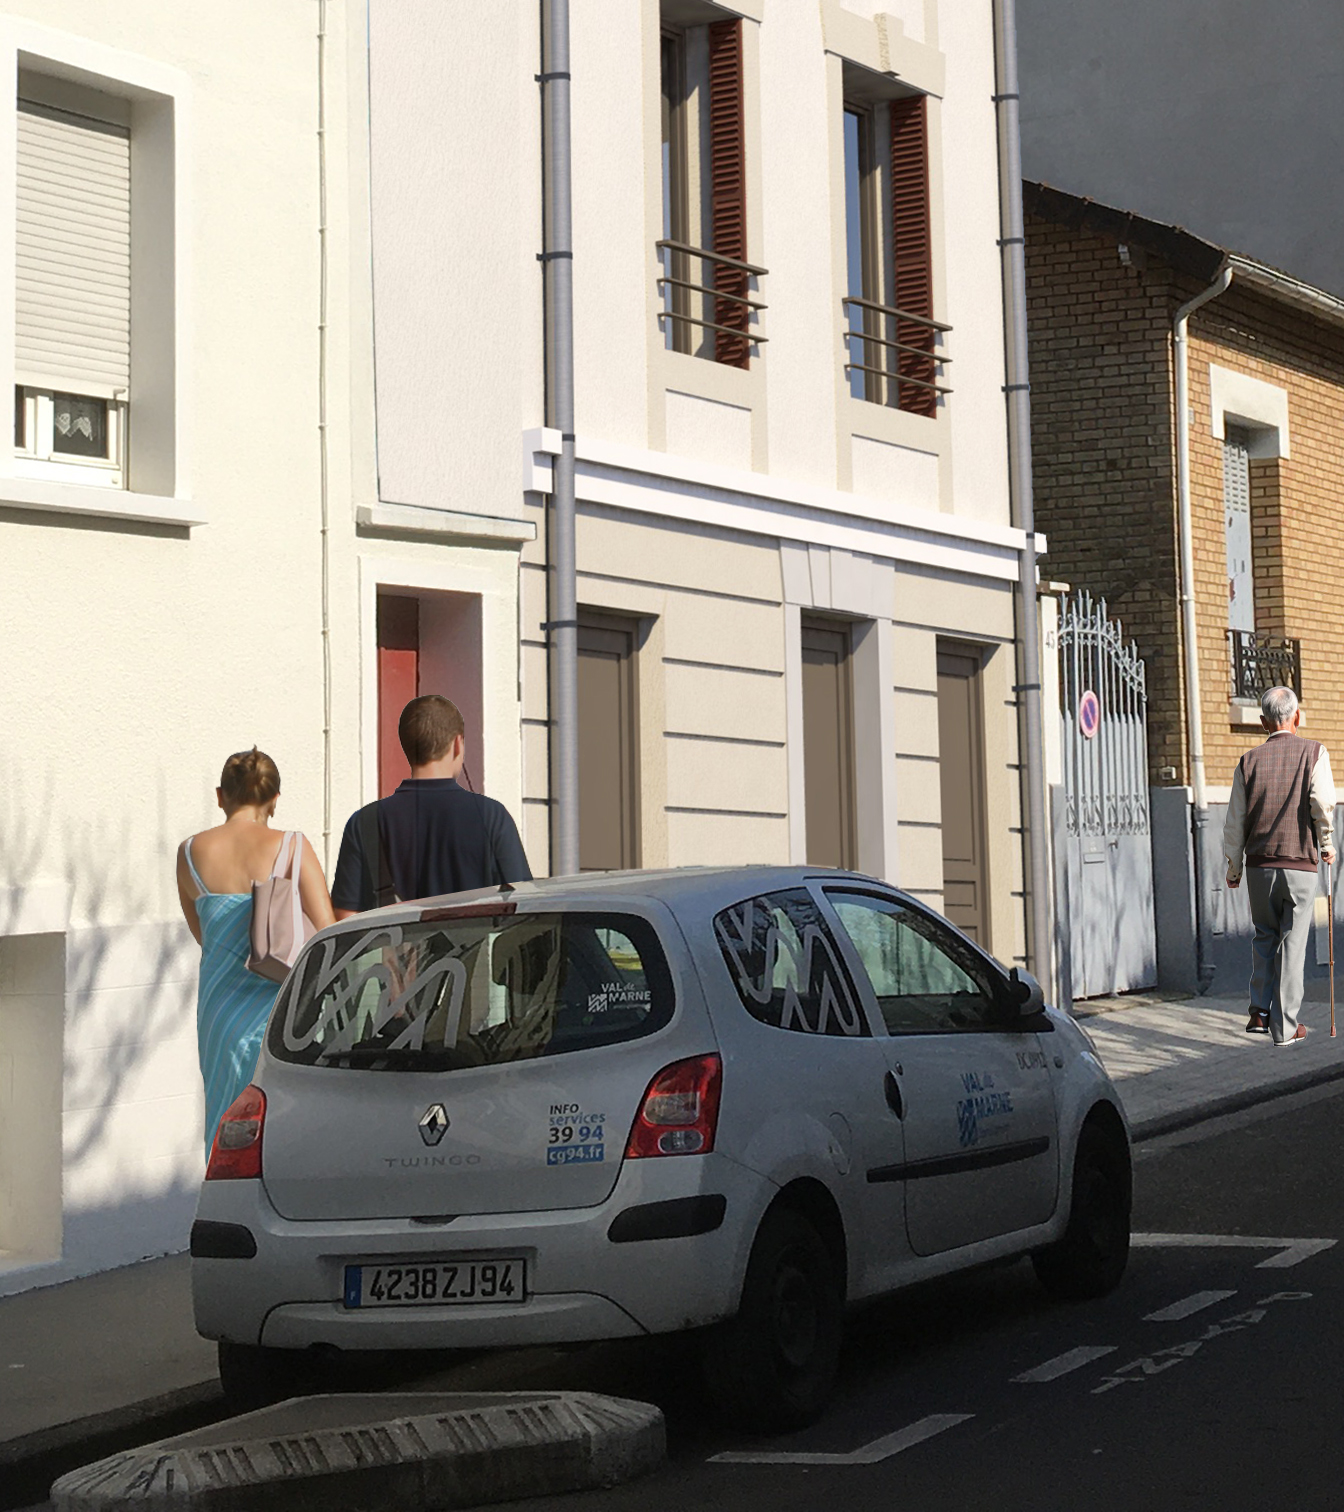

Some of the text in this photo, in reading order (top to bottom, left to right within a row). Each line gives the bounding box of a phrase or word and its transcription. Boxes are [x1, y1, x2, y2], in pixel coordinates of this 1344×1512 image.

[601, 982, 622, 992] VAL
[609, 991, 651, 1002] MARNE
[550, 1103, 579, 1115] INFO
[549, 1112, 606, 1126] services
[549, 1125, 604, 1144] 39 94
[549, 1146, 602, 1164] cg94.fr
